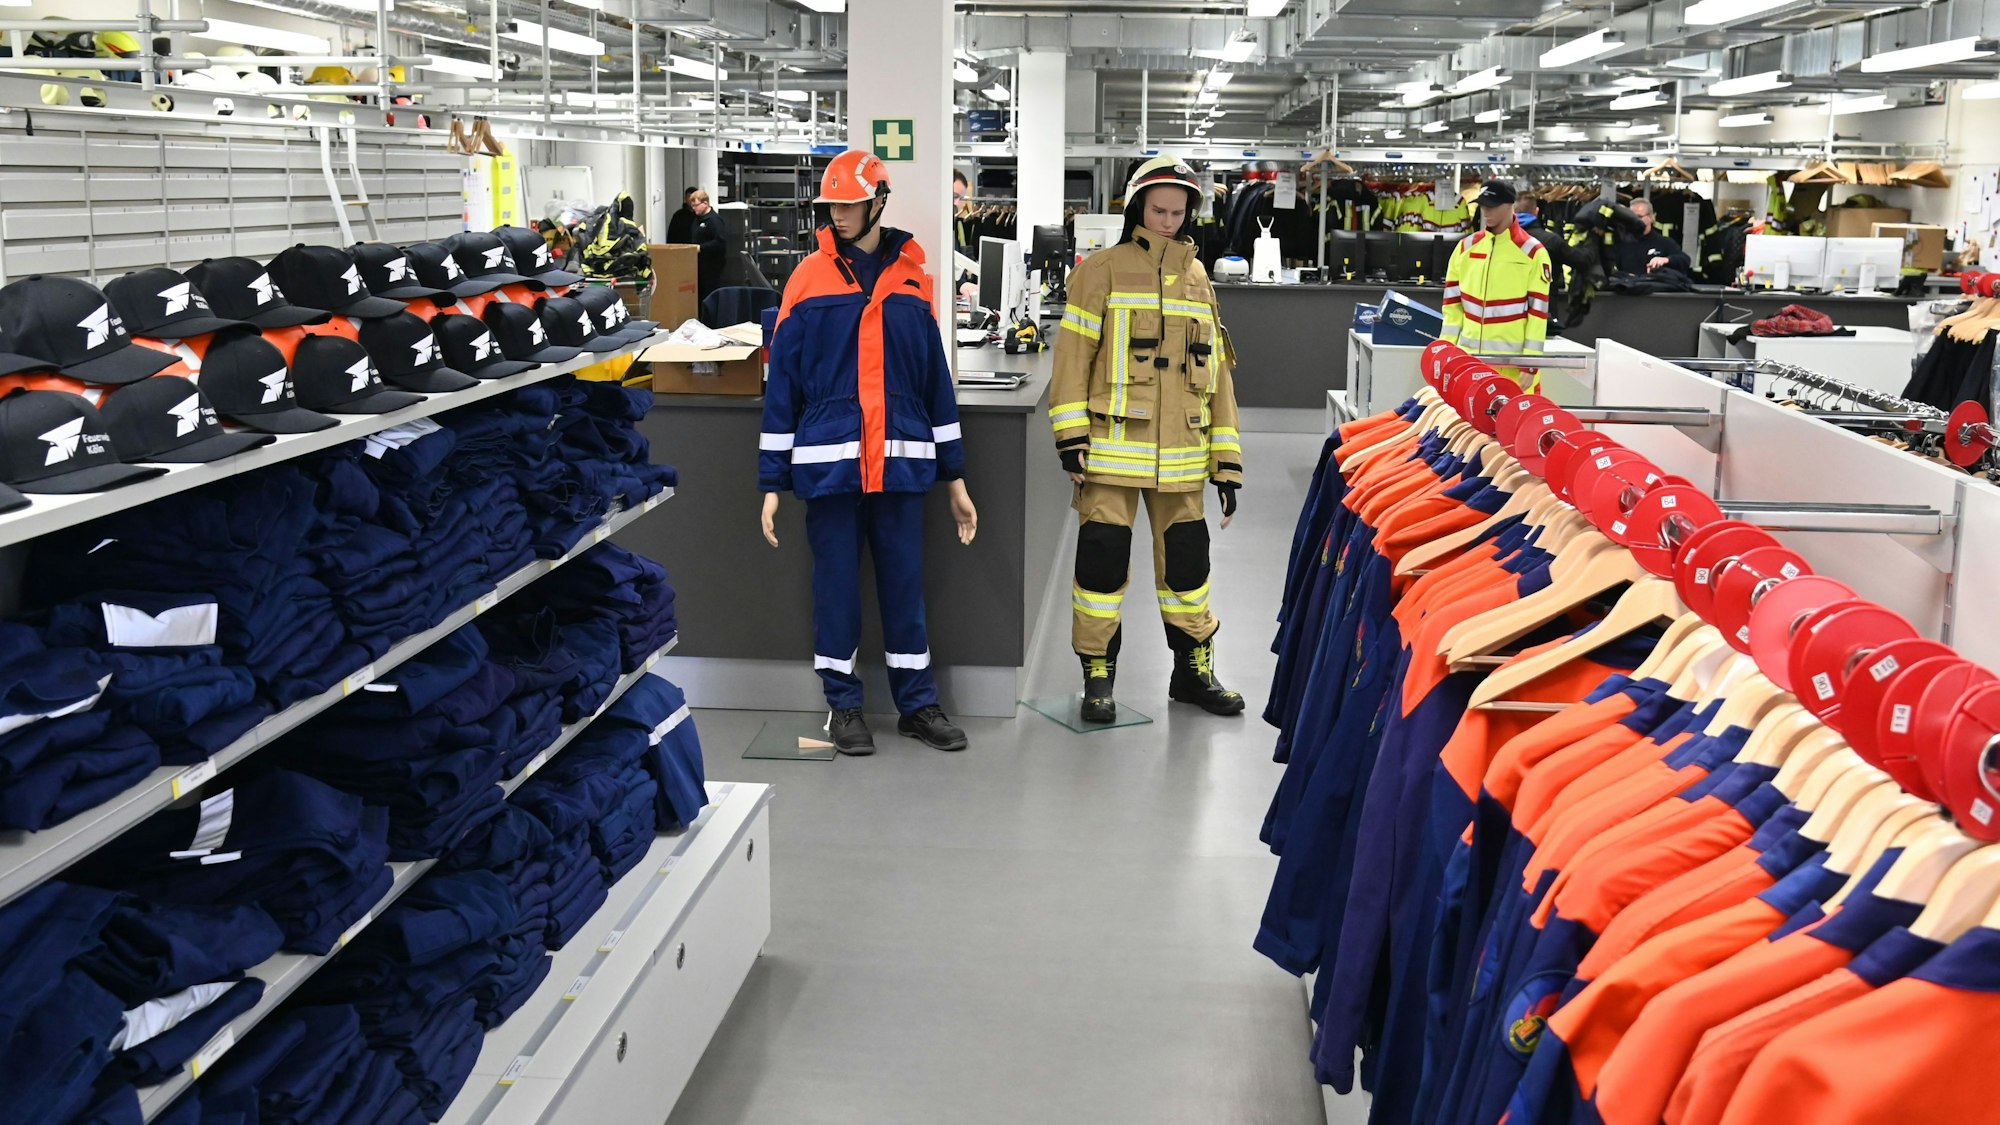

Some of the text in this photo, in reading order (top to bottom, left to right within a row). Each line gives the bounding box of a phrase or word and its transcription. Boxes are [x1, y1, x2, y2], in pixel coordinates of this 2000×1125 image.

[86, 443, 105, 455] Köln
[1663, 498, 1674, 506] 64
[1873, 658, 1896, 677] 110
[1894, 706, 1907, 728] 114
